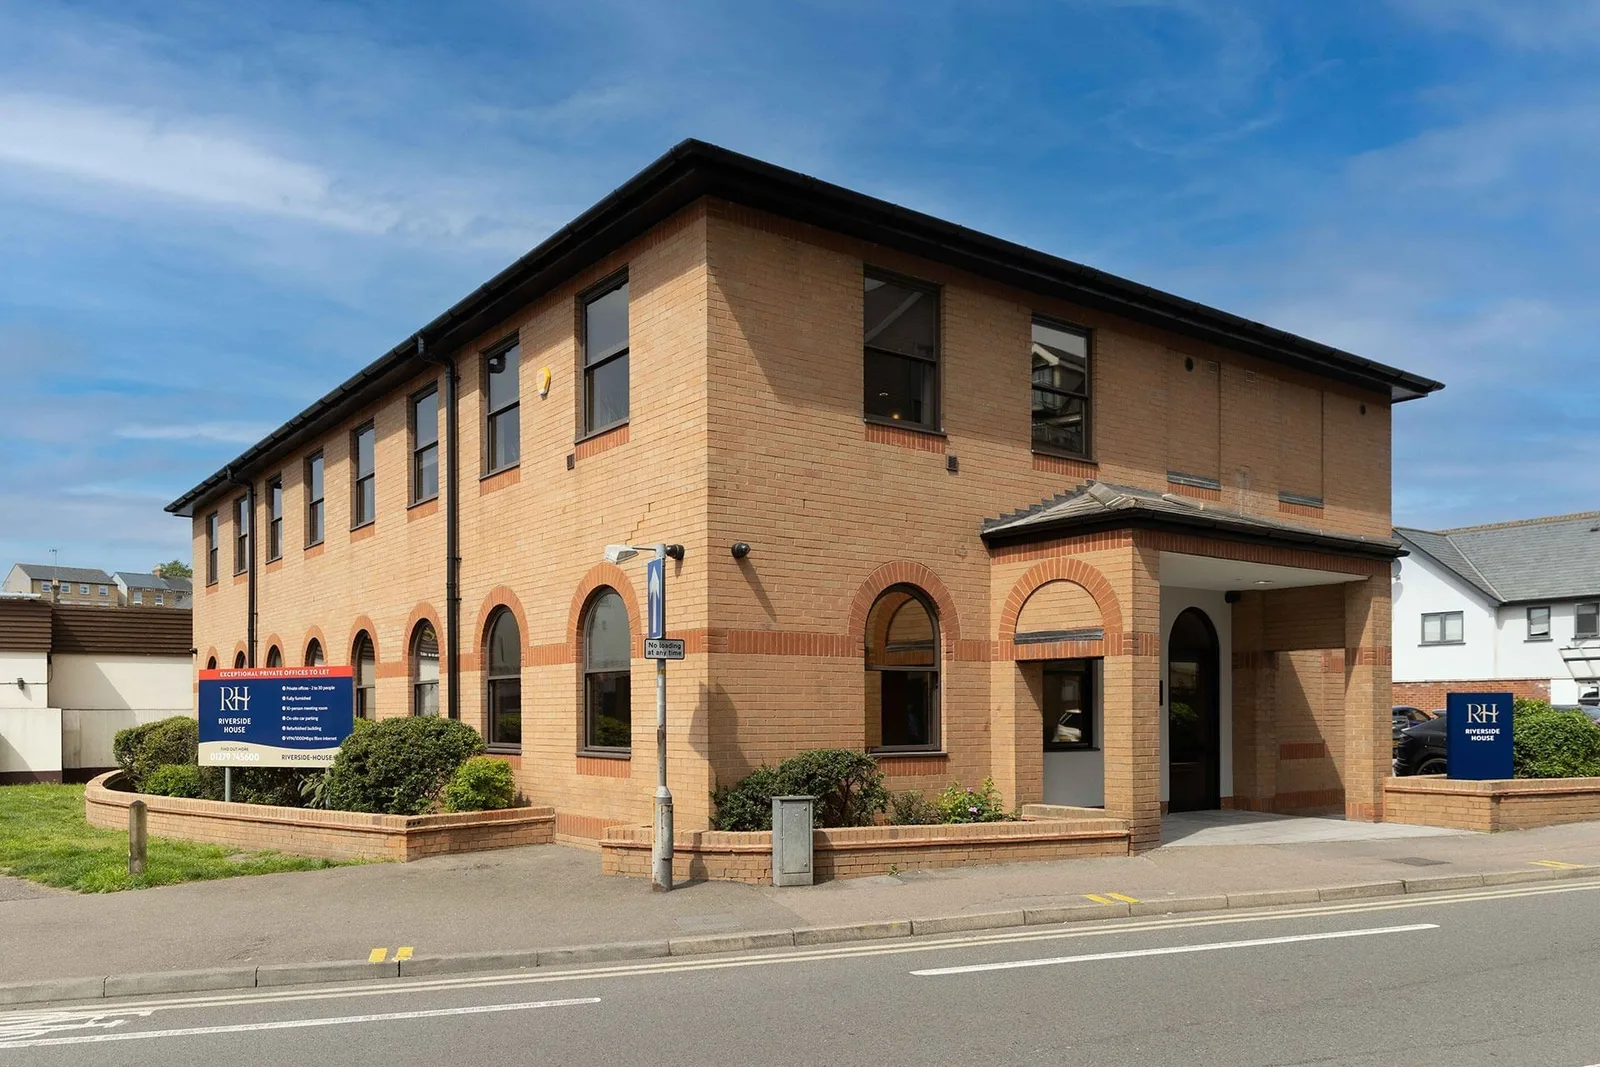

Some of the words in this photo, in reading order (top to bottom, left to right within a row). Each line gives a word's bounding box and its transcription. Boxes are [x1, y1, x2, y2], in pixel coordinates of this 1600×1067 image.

[220, 686, 251, 711] RH
[1466, 704, 1500, 724] RH
[210, 752, 230, 760] 01279
[232, 752, 260, 761] 745600
